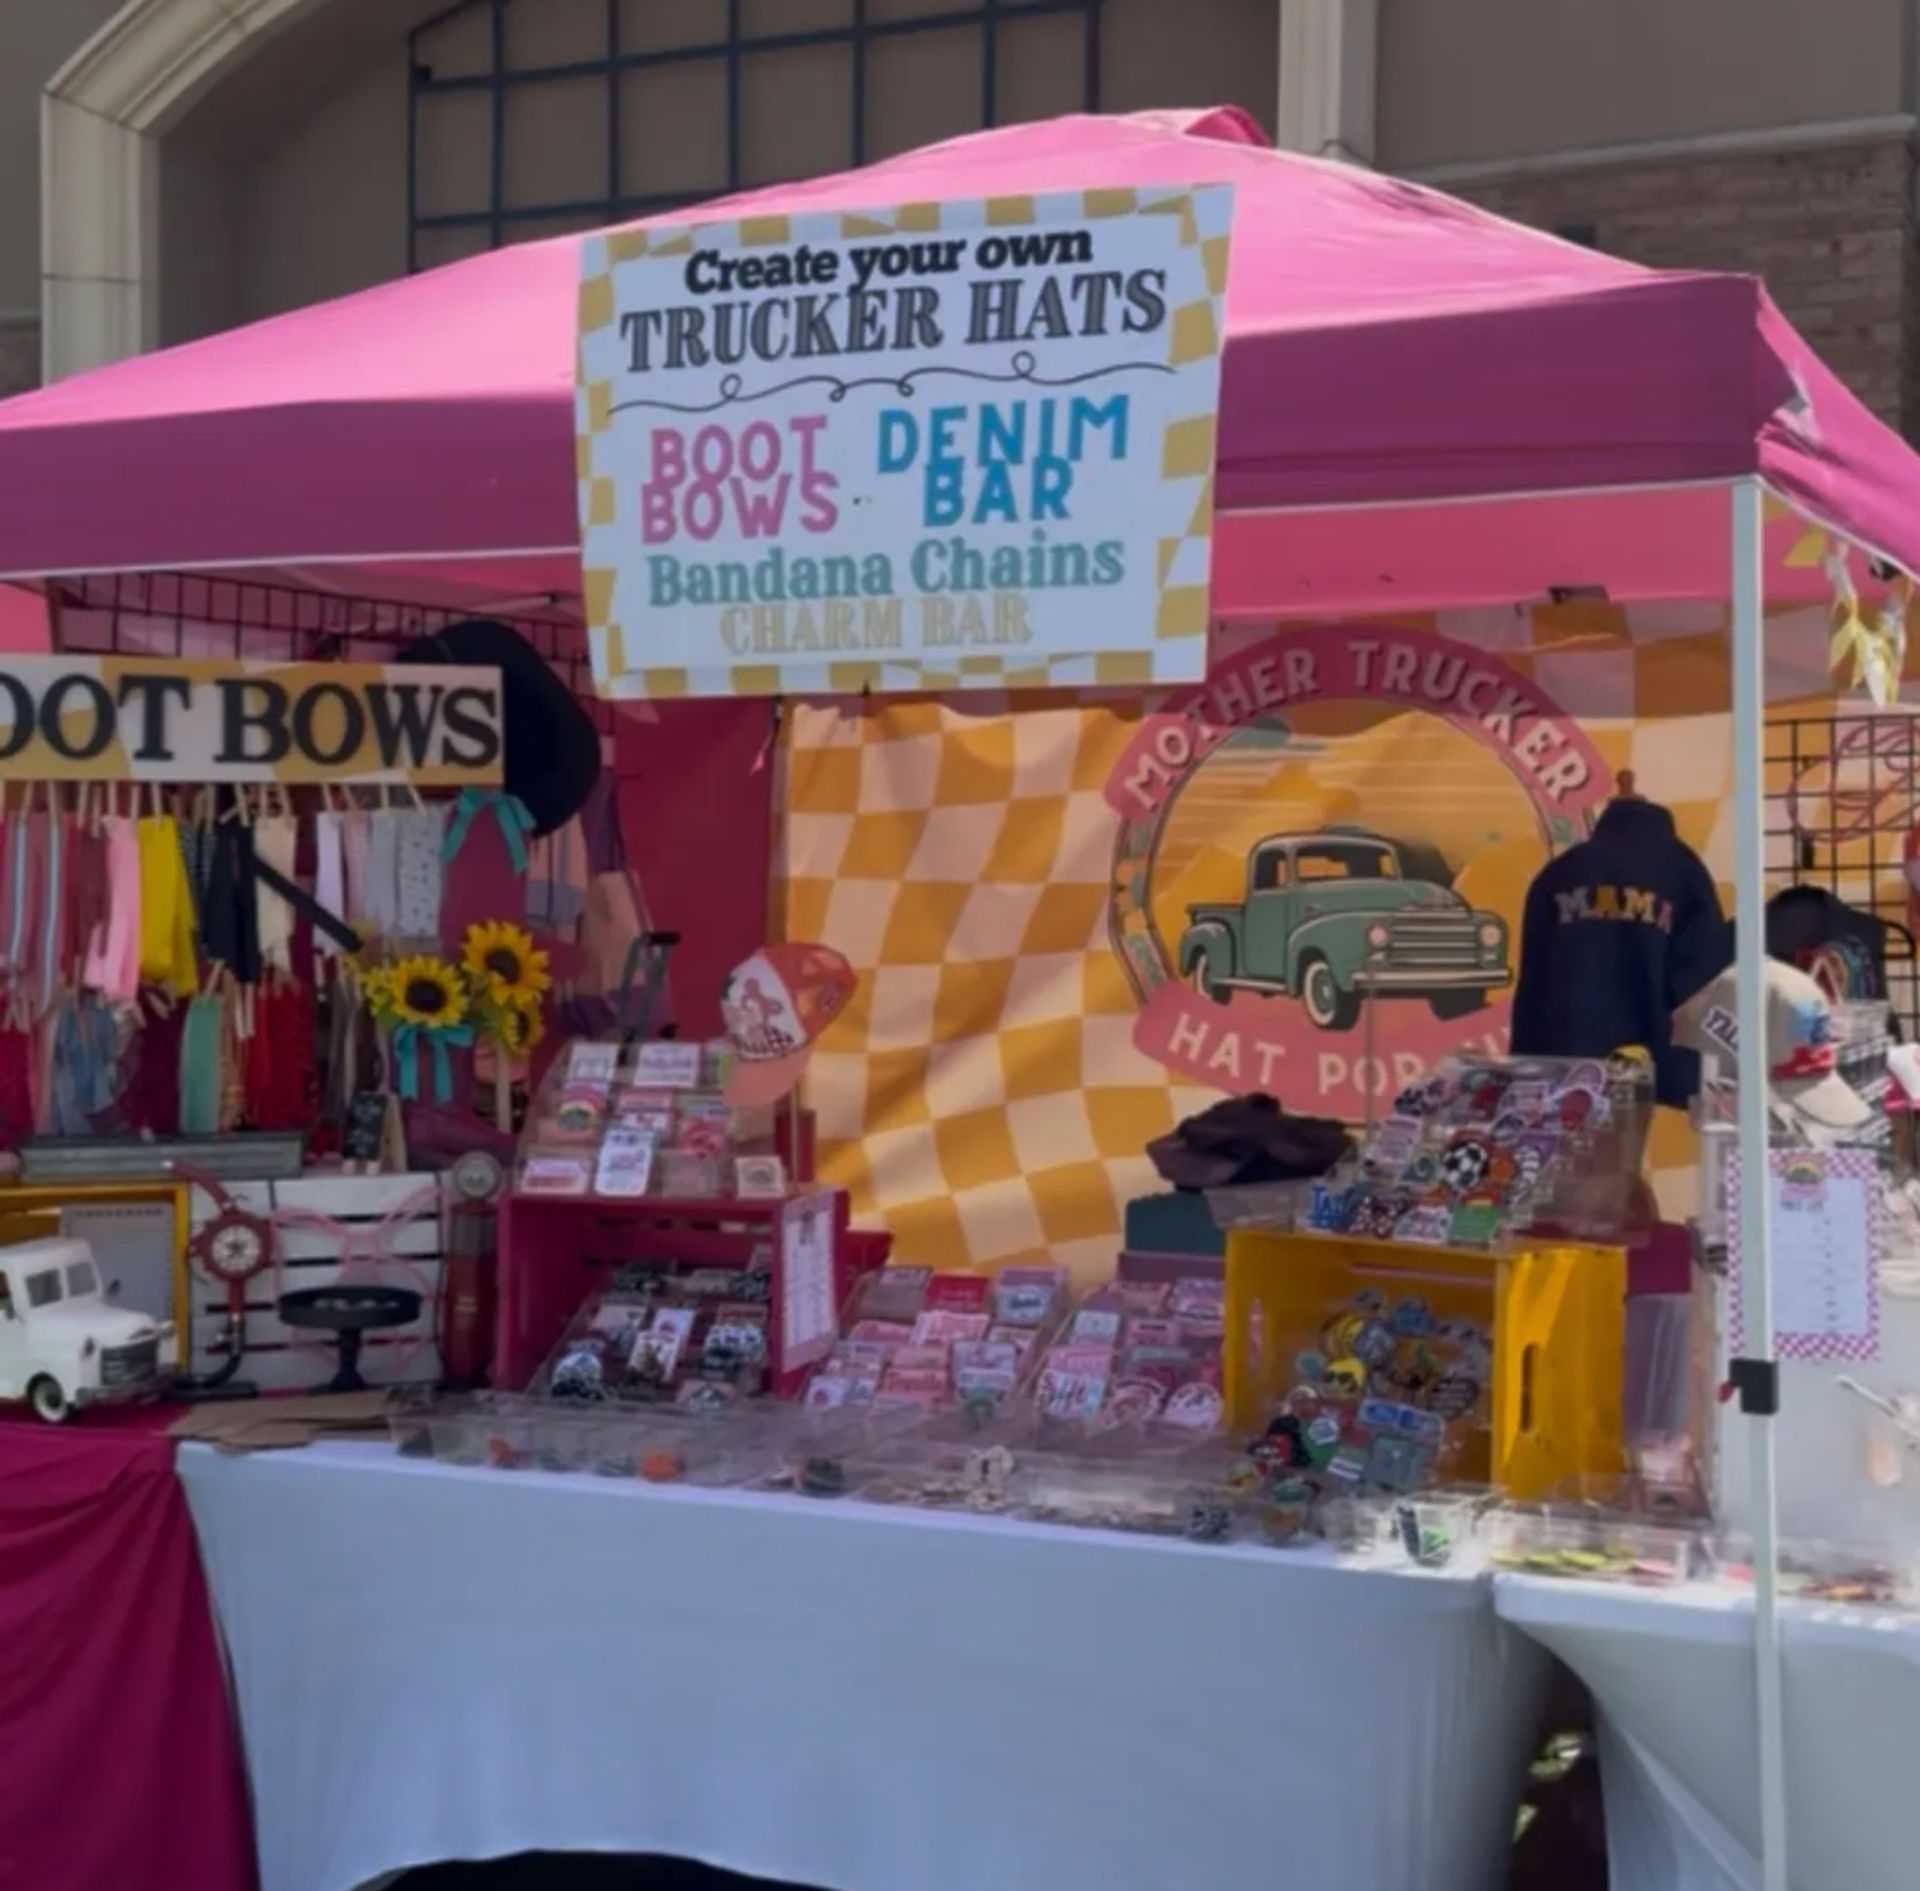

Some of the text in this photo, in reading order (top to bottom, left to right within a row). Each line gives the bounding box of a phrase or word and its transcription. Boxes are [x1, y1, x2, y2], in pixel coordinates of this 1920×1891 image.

[684, 229, 1093, 296] Create your own
[620, 268, 1168, 374] TRUCKER HATS
[649, 414, 828, 490] BOOT
[877, 393, 1130, 474] DENIM
[640, 472, 840, 546] BOWS
[923, 454, 1074, 528] BAR
[646, 527, 1125, 608] Bandana Chains
[719, 591, 1033, 657] CHARM BAR
[213, 677, 500, 770] BOWS
[1123, 640, 1590, 809] MOTHER TRUCKER
[1166, 1011, 1286, 1086] HAT
